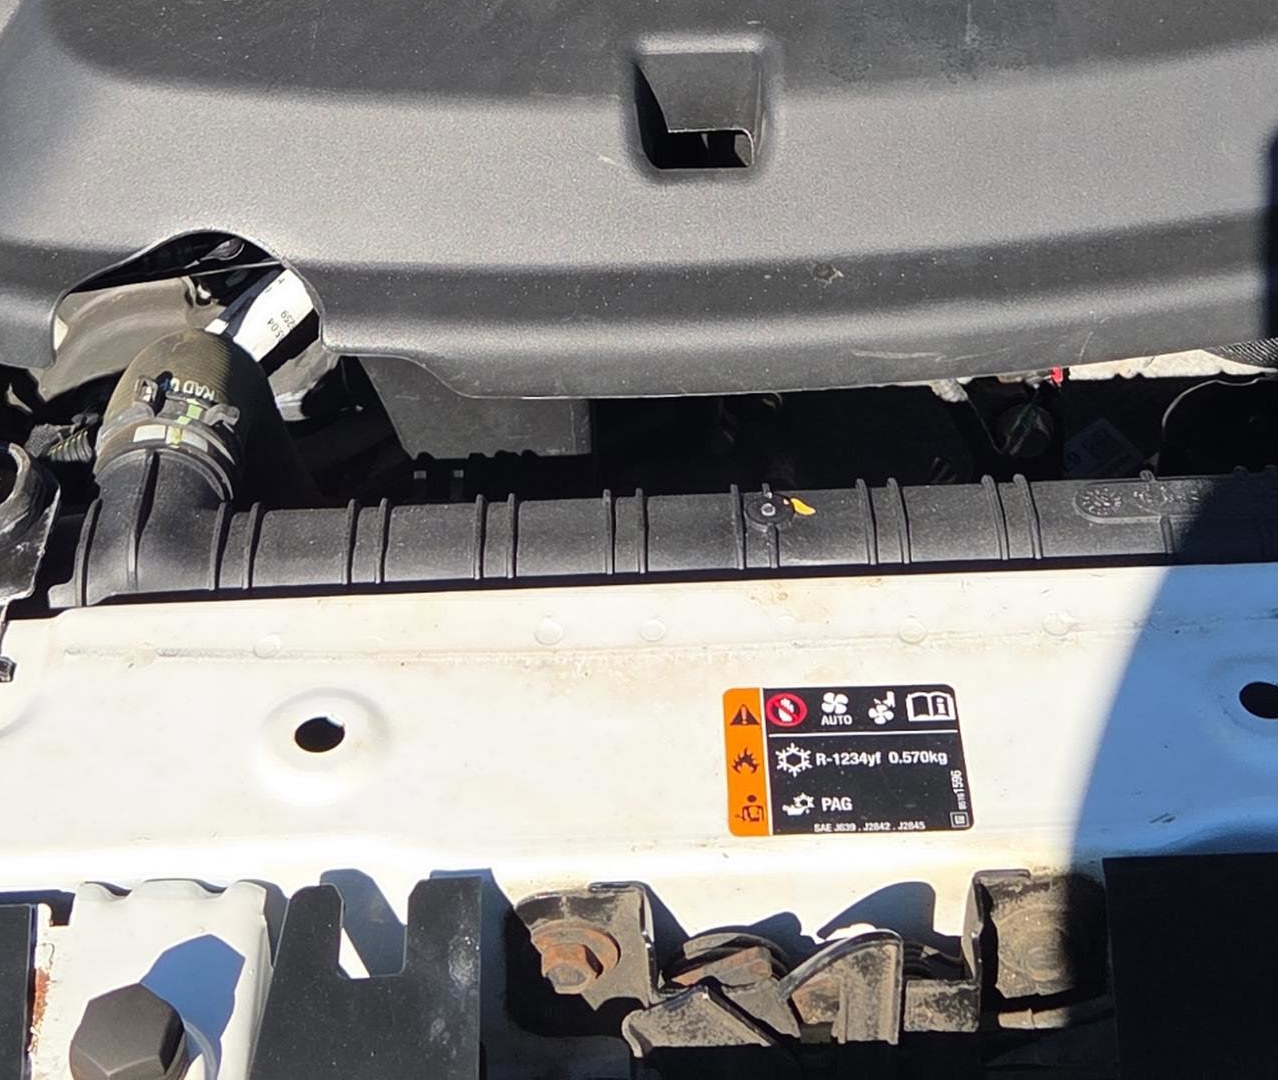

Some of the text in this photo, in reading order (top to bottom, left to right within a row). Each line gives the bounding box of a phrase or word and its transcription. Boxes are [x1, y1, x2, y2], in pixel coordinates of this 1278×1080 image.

[821, 715, 853, 726] AUTO
[815, 750, 948, 768] R-1234yf 0.570kg
[821, 796, 853, 812] PAG
[813, 822, 832, 832] SAE
